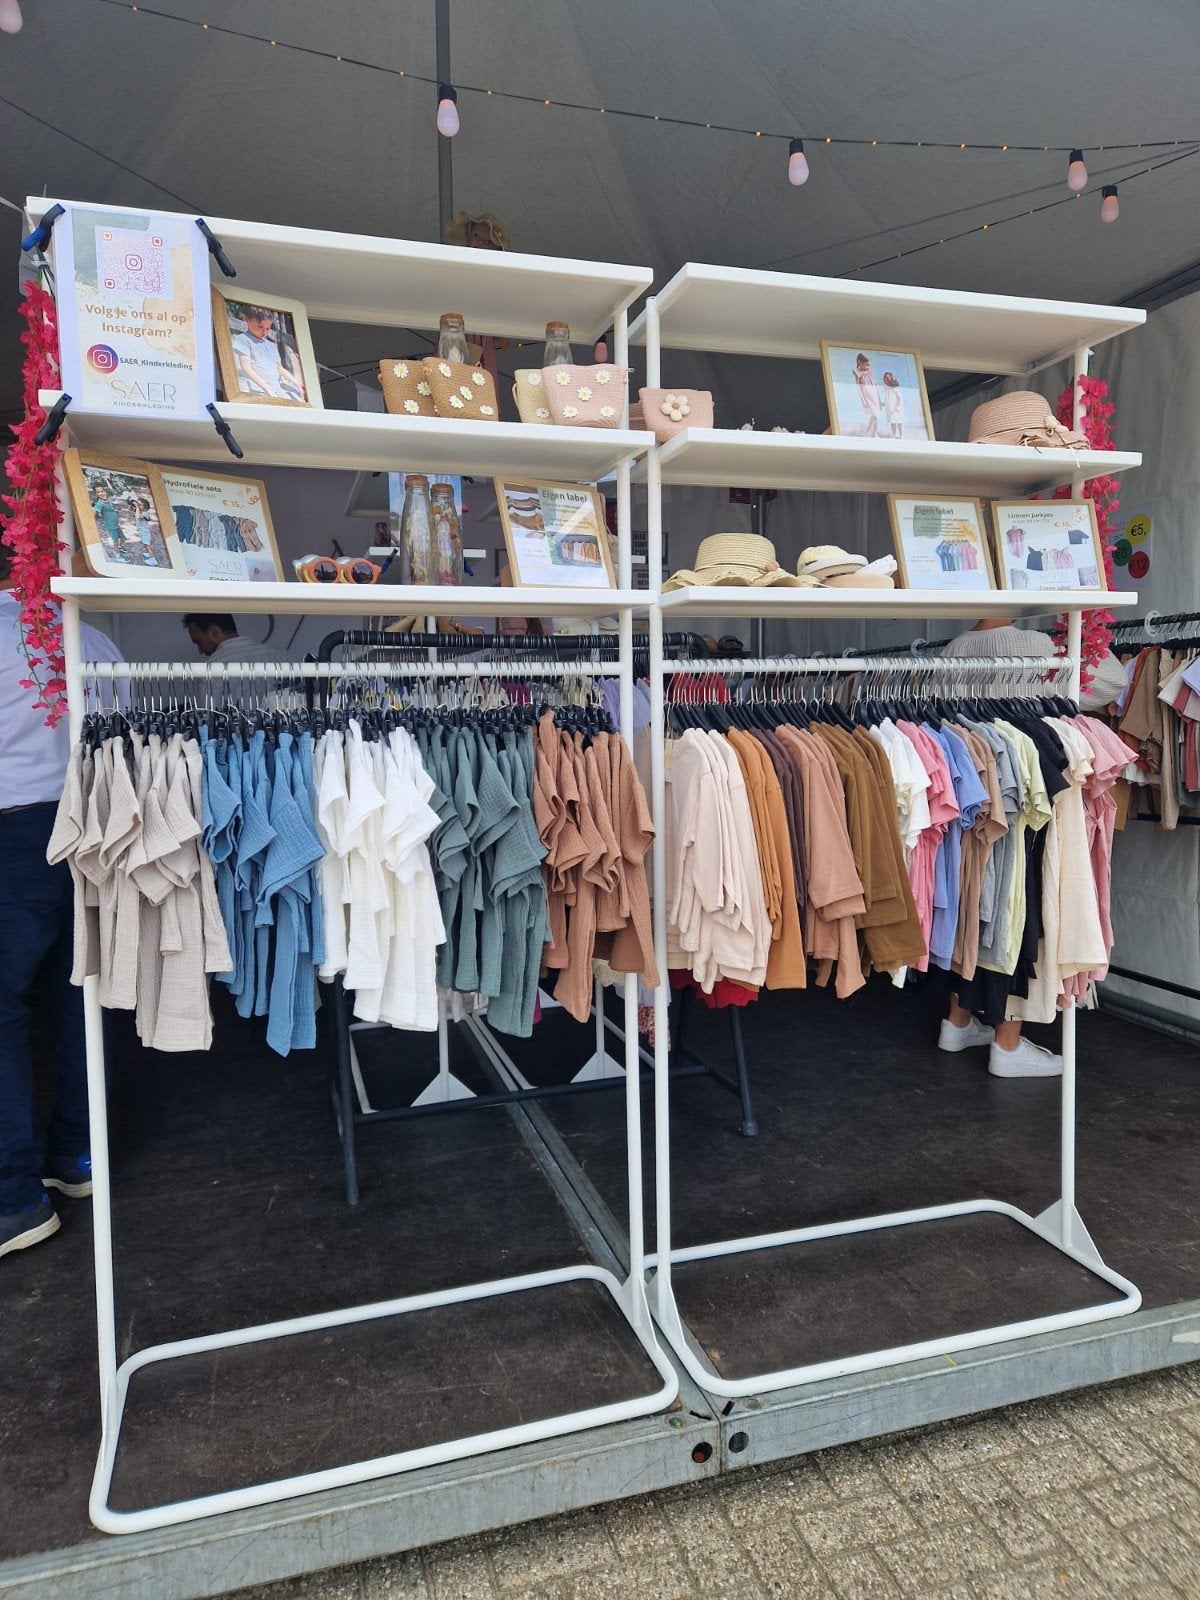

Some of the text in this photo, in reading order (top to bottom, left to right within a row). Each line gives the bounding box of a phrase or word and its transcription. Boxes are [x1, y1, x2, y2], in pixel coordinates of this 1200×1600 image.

[85, 304, 187, 325] Volg je ons al op
[102, 323, 172, 338] Instagram?
[111, 379, 176, 402] SAER
[163, 479, 204, 490] Hydrofiele
[542, 490, 588, 502] Eigen label
[915, 507, 935, 515] Eigen
